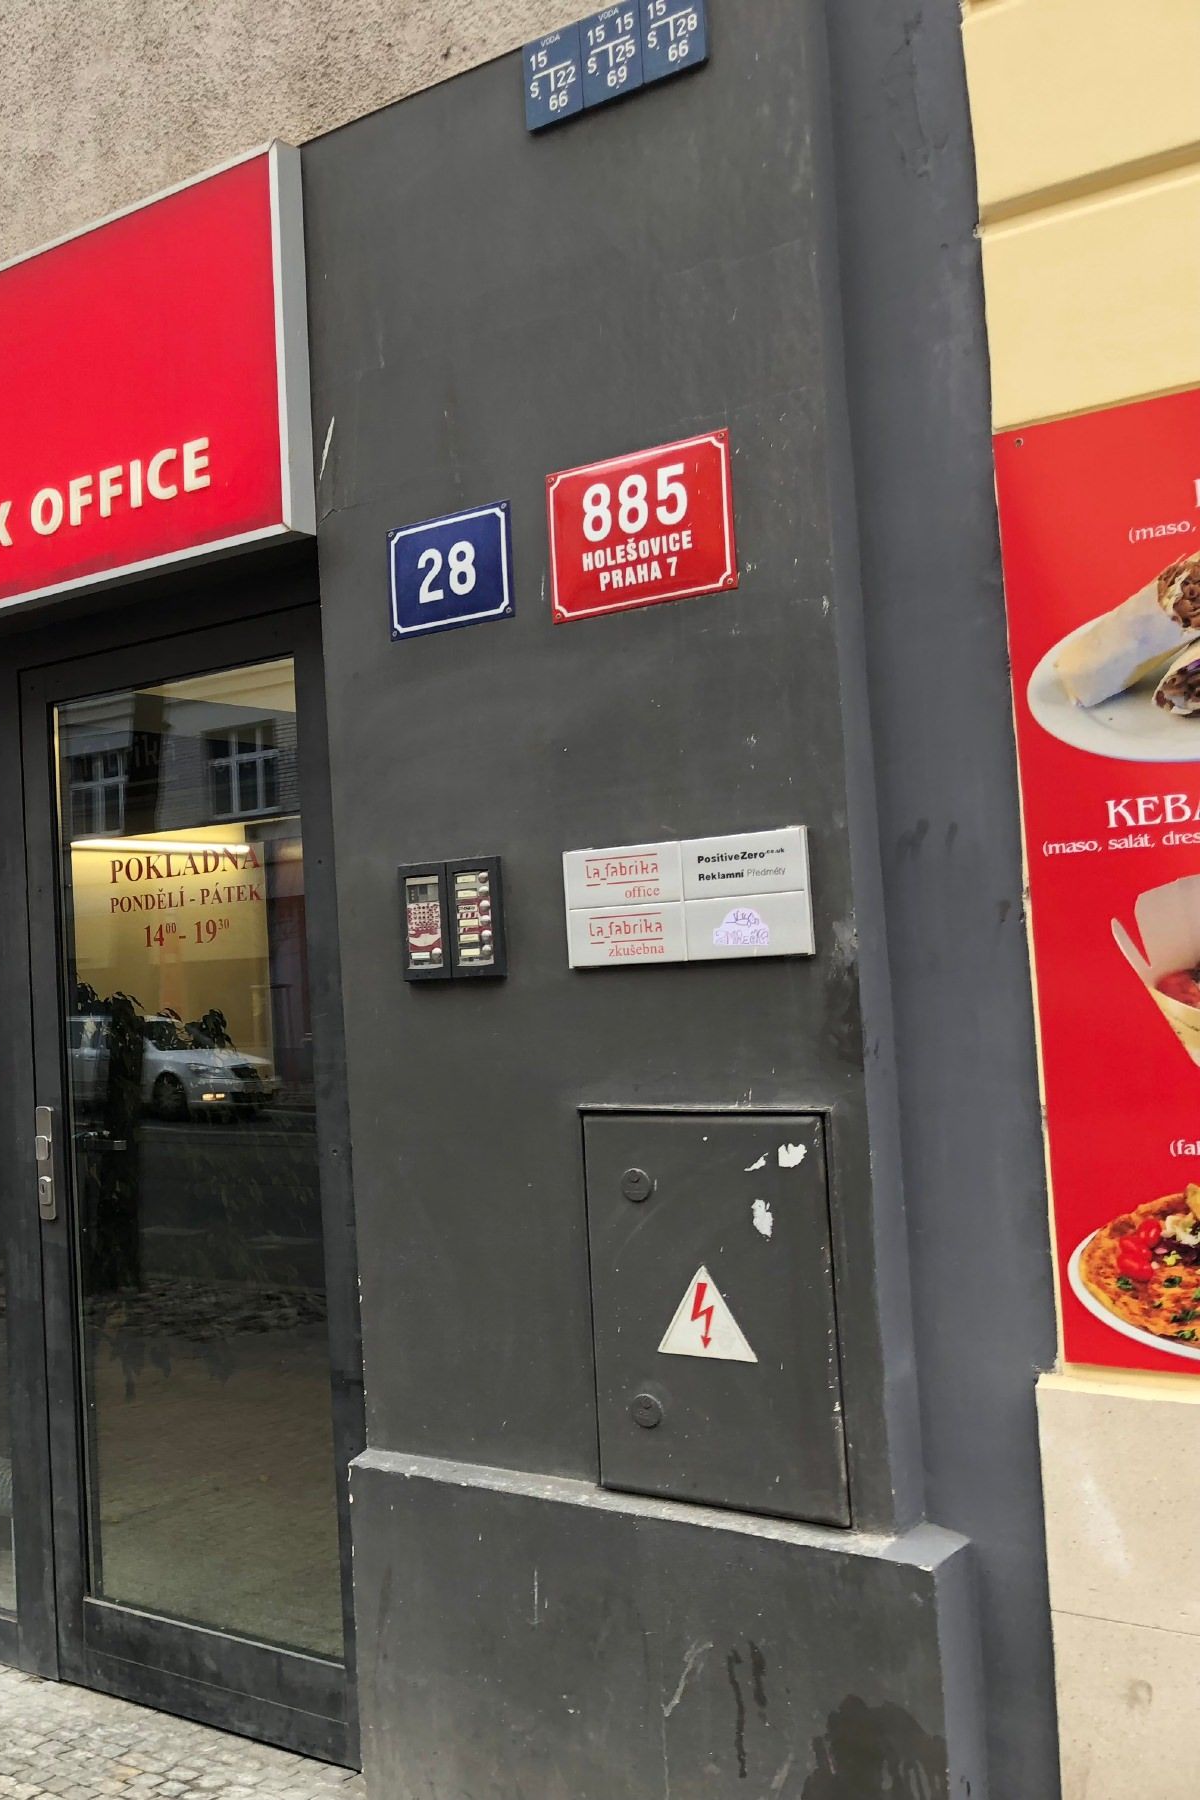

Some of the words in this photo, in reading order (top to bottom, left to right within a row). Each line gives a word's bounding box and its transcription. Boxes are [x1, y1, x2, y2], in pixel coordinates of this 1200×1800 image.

[587, 25, 605, 46] 15
[615, 12, 634, 34] 15
[530, 50, 548, 71] 15
[30, 437, 211, 535] OFFICE
[582, 463, 688, 542] 885
[1128, 520, 1197, 544] (maso,
[582, 530, 692, 572] HOLEŠOVICE
[417, 541, 476, 604] 28
[599, 566, 662, 592] PRAHA
[667, 557, 678, 578] 7
[1042, 840, 1103, 857] (maso,
[1108, 833, 1155, 850] salát,
[110, 845, 262, 883] POKLADNA
[698, 869, 745, 881] Reklamní
[110, 886, 185, 913] PONDĚLÍ
[200, 882, 264, 905] PÁTEK
[624, 886, 661, 899] office
[608, 943, 665, 957] zkušebna
